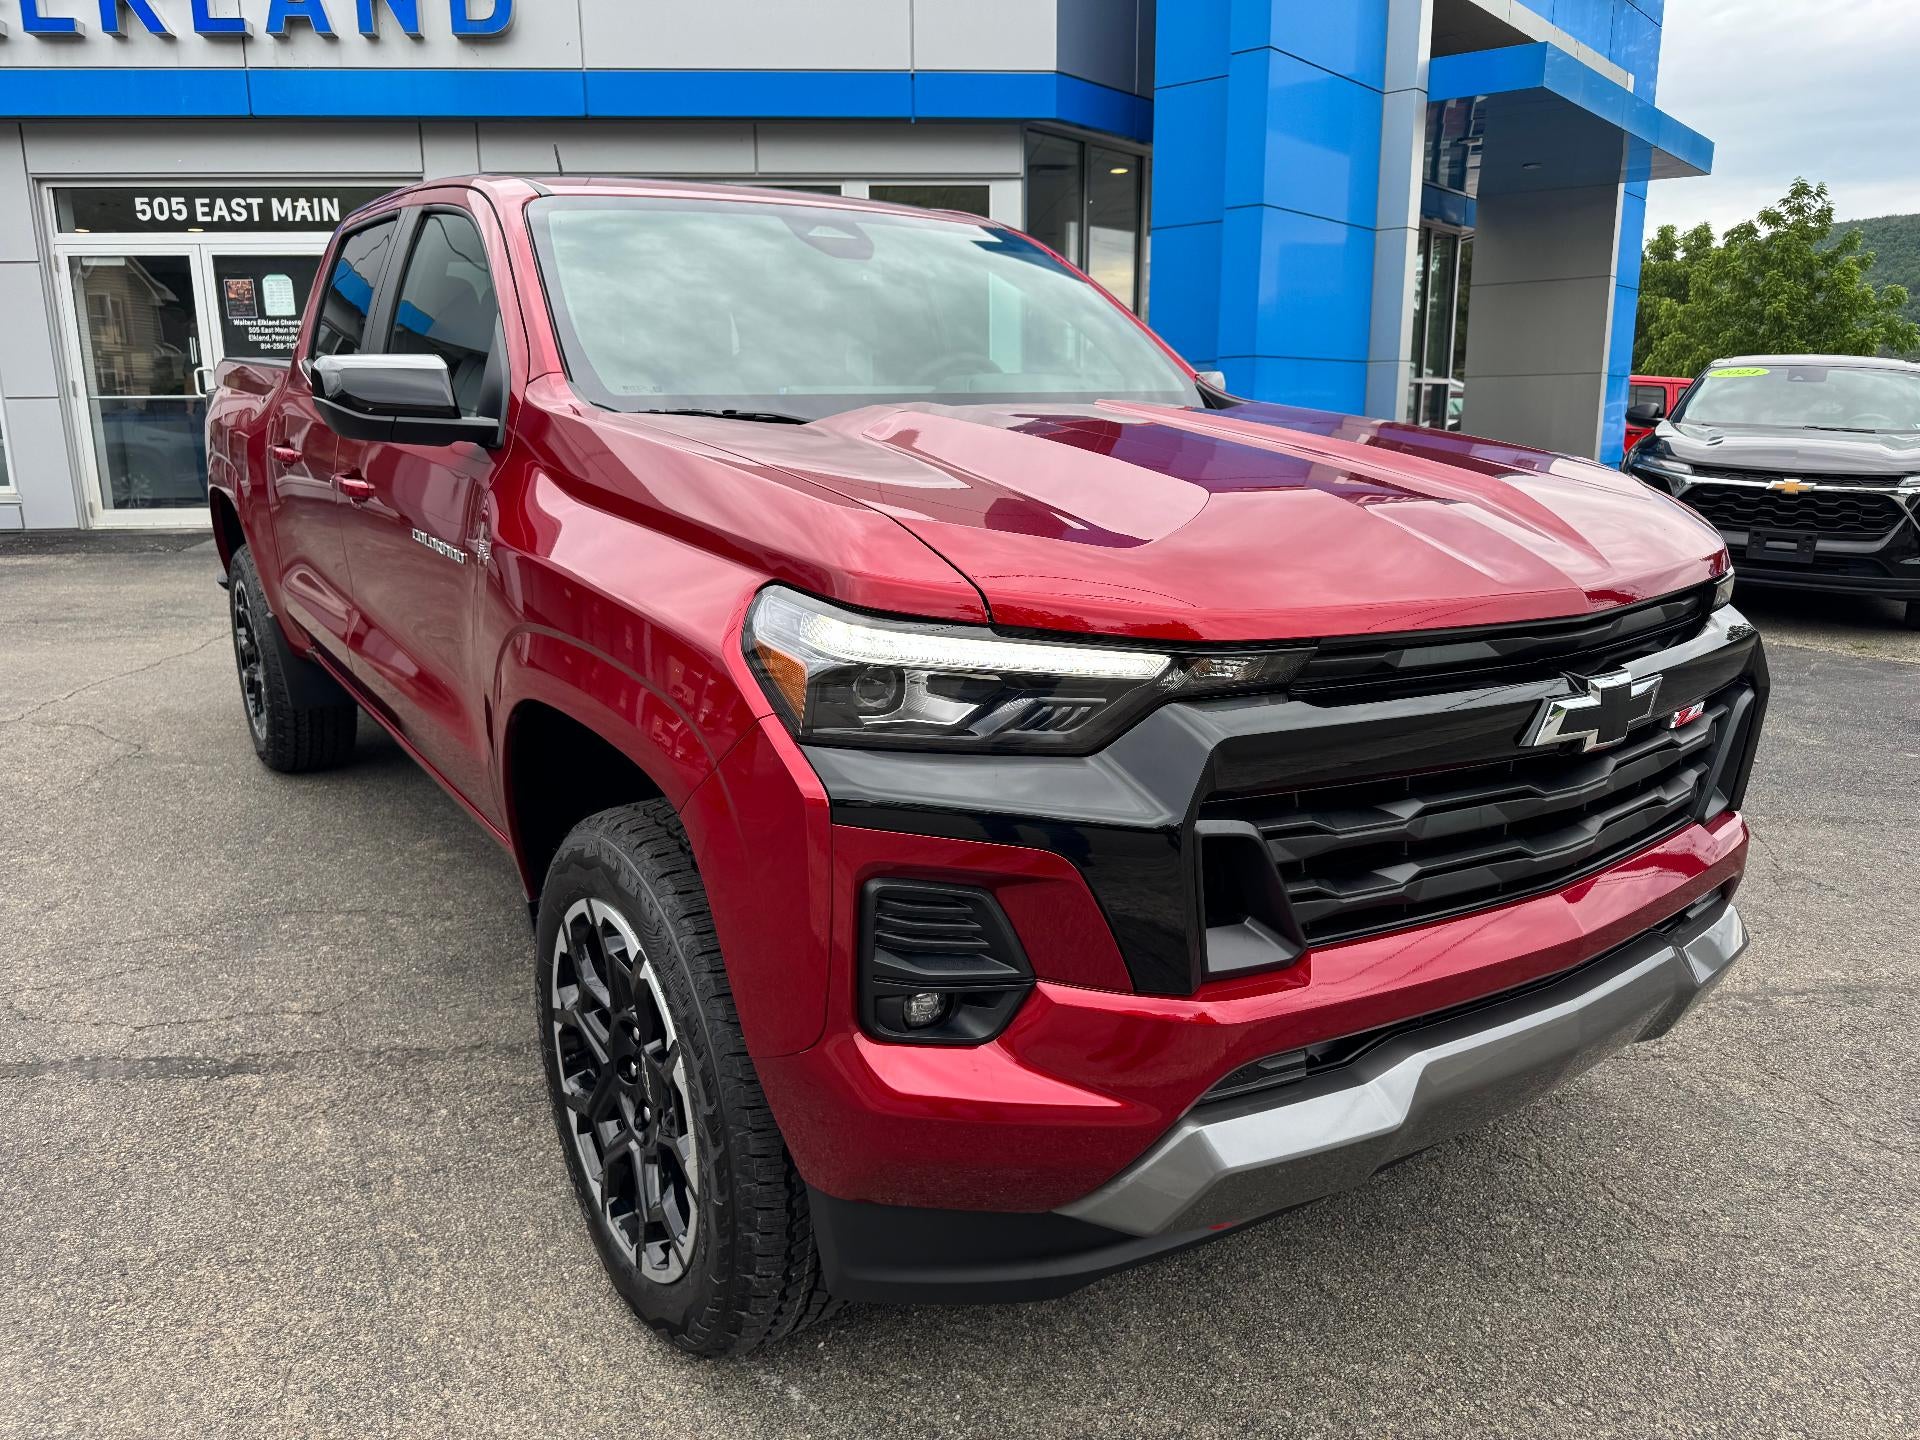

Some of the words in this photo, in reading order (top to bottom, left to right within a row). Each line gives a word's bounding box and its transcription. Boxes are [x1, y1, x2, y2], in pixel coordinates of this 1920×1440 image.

[134, 197, 188, 221] 505
[195, 198, 263, 222] EAST
[271, 198, 340, 222] MAIN
[248, 326, 260, 334] 505
[261, 326, 274, 334] East
[275, 326, 289, 334] Main
[412, 528, 465, 564] COLORADO
